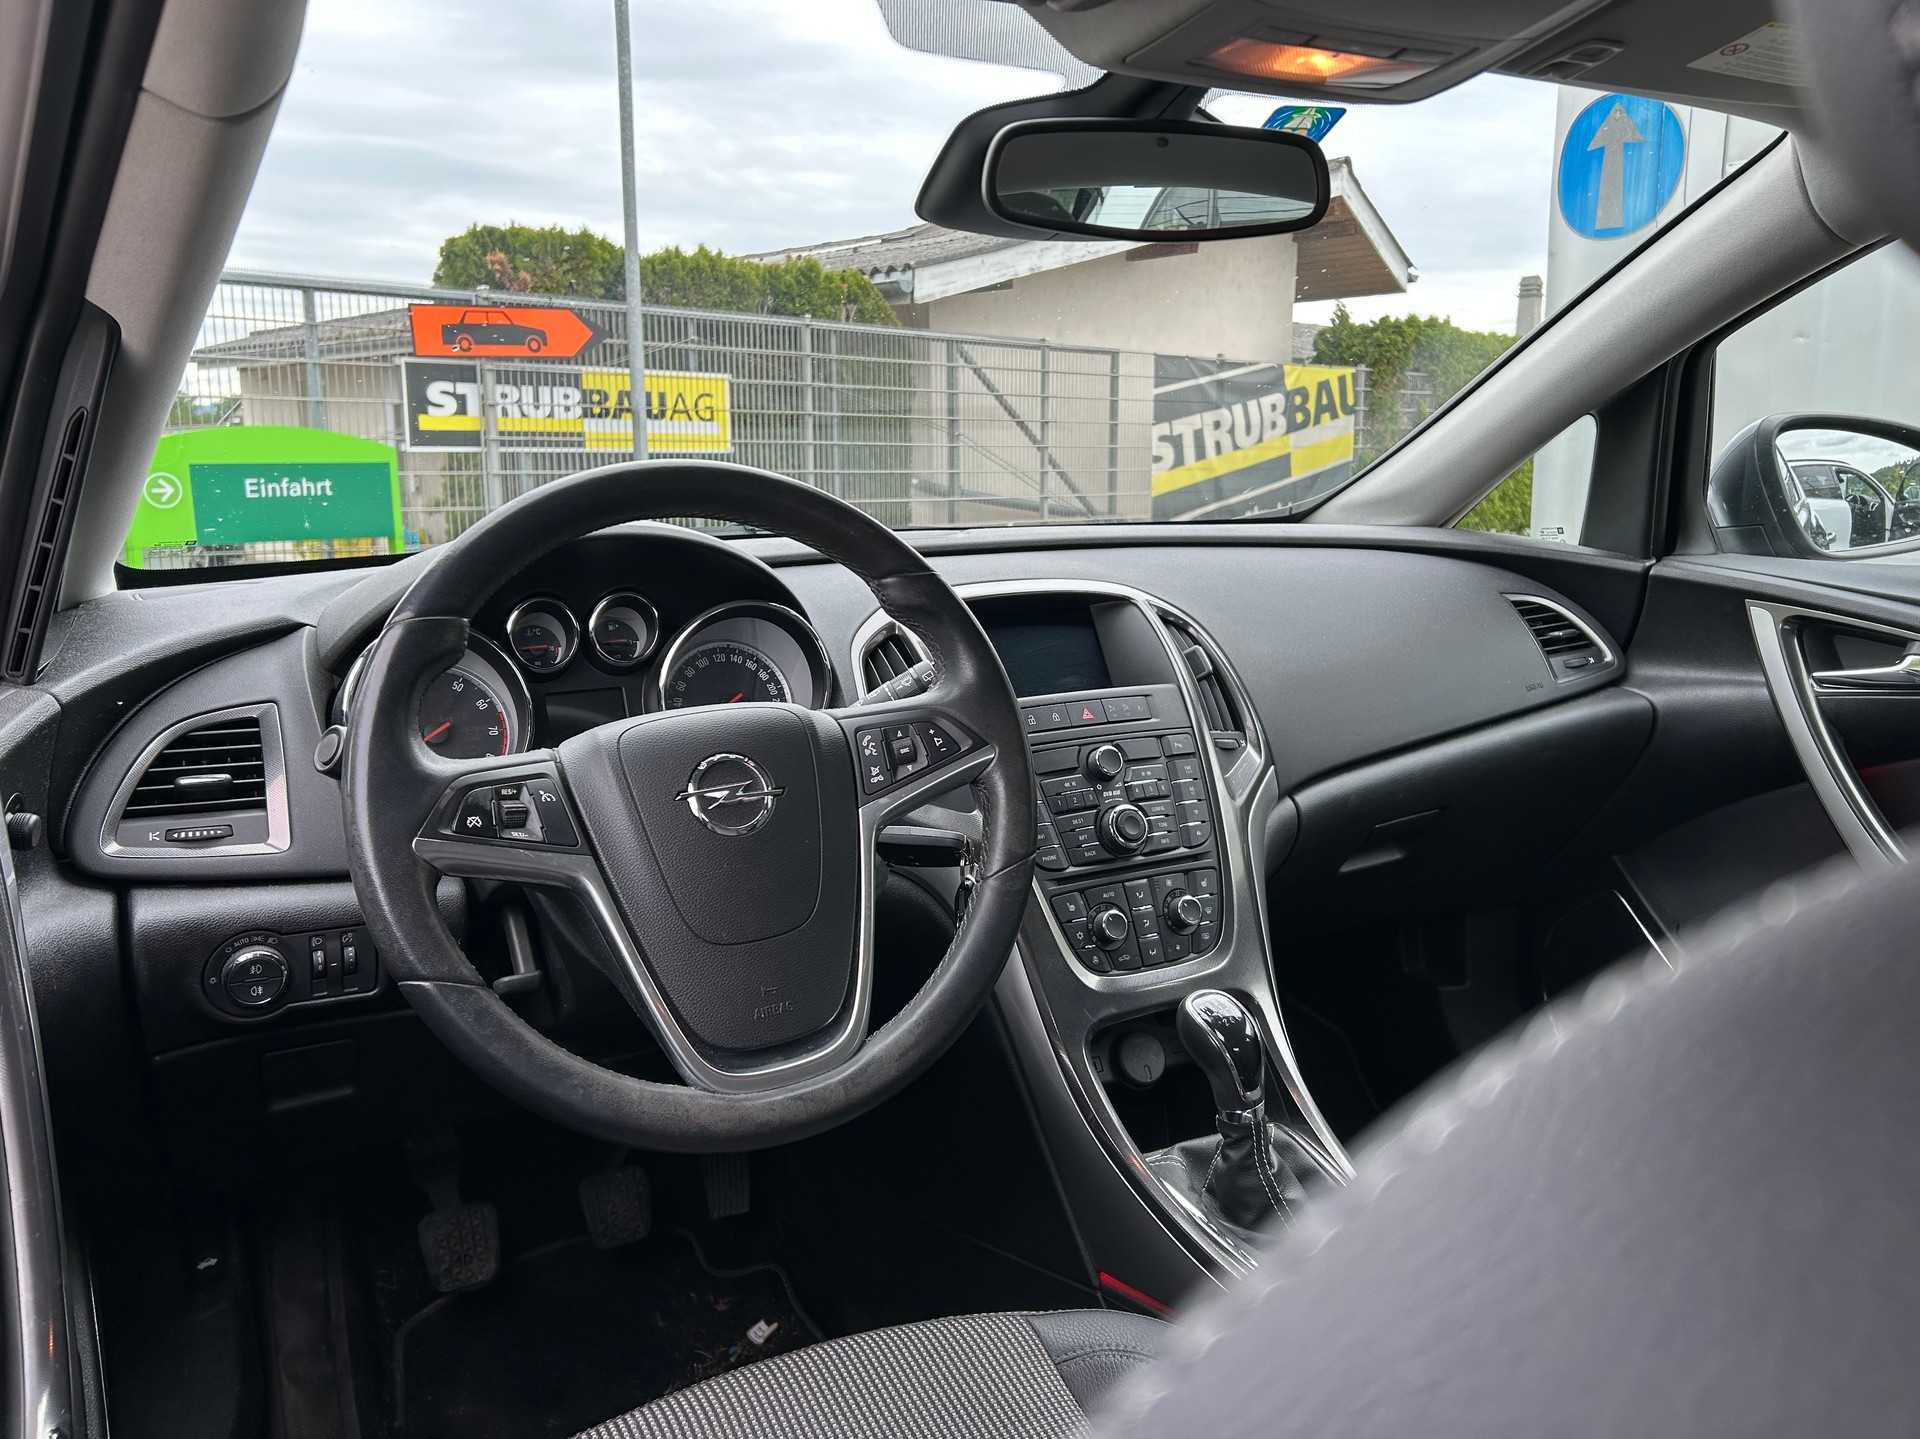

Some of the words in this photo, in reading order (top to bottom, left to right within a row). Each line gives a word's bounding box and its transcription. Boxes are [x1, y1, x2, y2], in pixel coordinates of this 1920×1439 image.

[244, 476, 334, 498] Einfahrt
[696, 656, 710, 669] 100
[712, 653, 726, 663] 120
[729, 653, 743, 664] 140
[744, 658, 758, 671] 160
[683, 666, 696, 678] 80
[757, 668, 770, 682] 180
[451, 680, 464, 692] 50
[675, 680, 687, 692] 60
[766, 681, 778, 696] 200
[475, 698, 488, 710] 60
[673, 696, 683, 708] 40
[487, 725, 499, 736] 70
[1042, 854, 1057, 862] PHONE
[234, 937, 250, 948] AUTO
